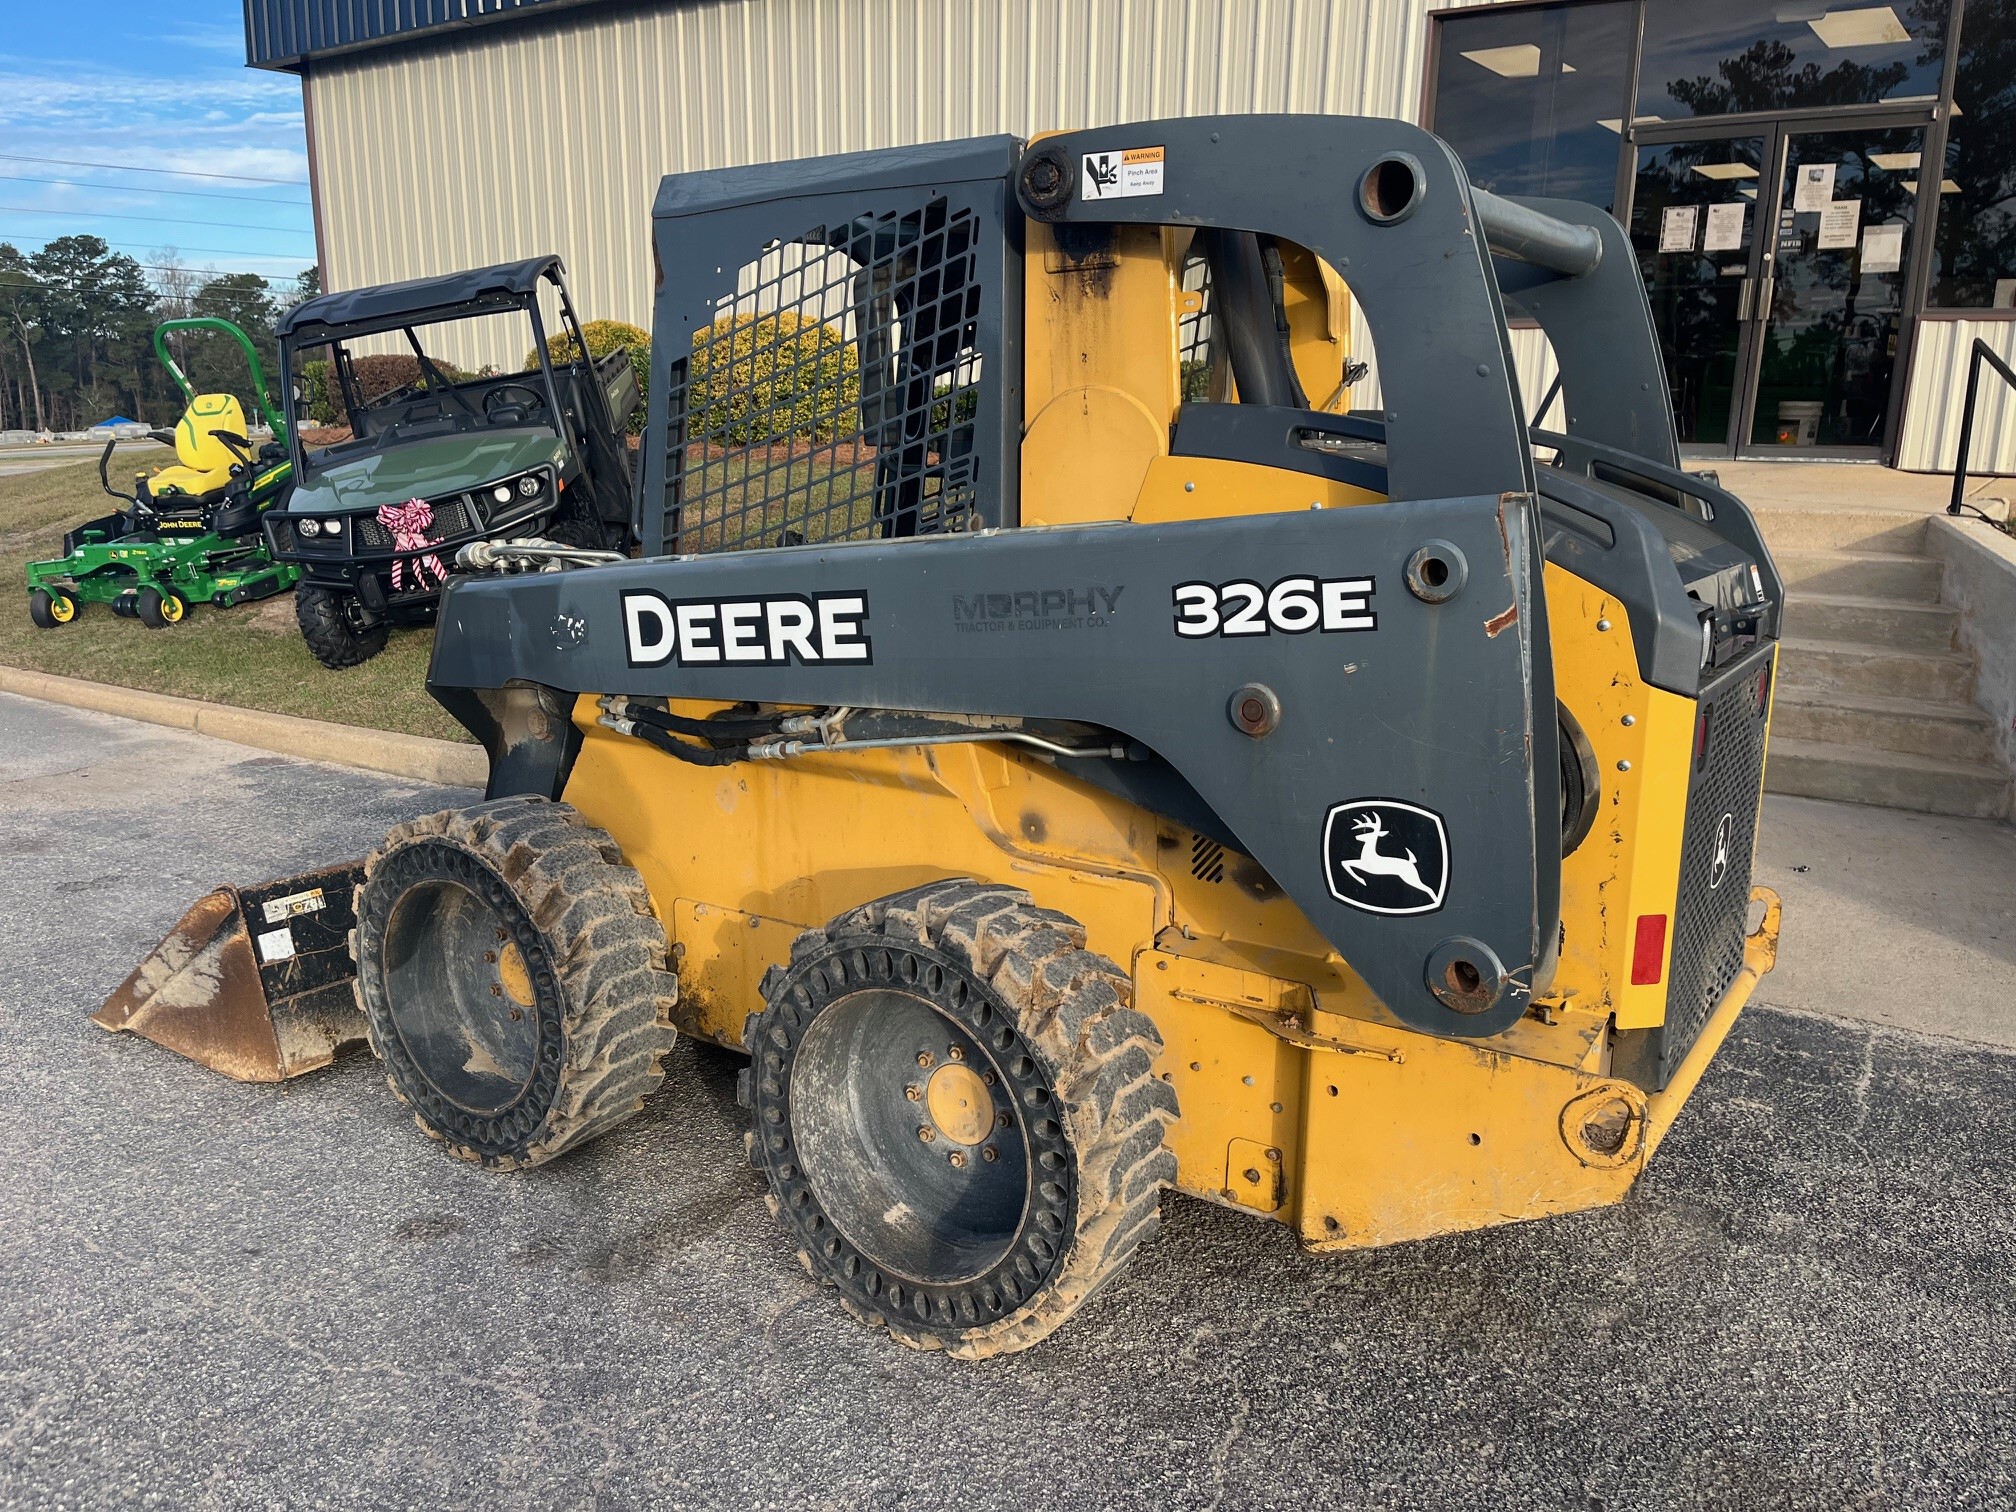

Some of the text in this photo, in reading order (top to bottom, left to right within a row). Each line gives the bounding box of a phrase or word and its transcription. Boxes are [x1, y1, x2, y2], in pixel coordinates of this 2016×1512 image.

[1130, 151, 1160, 160] WARNING
[178, 520, 202, 528] DEERE
[1174, 577, 1375, 636] 326E
[623, 593, 868, 663] DEERE
[955, 617, 1108, 632] TRACTOR & EQUIPMENT CO.
